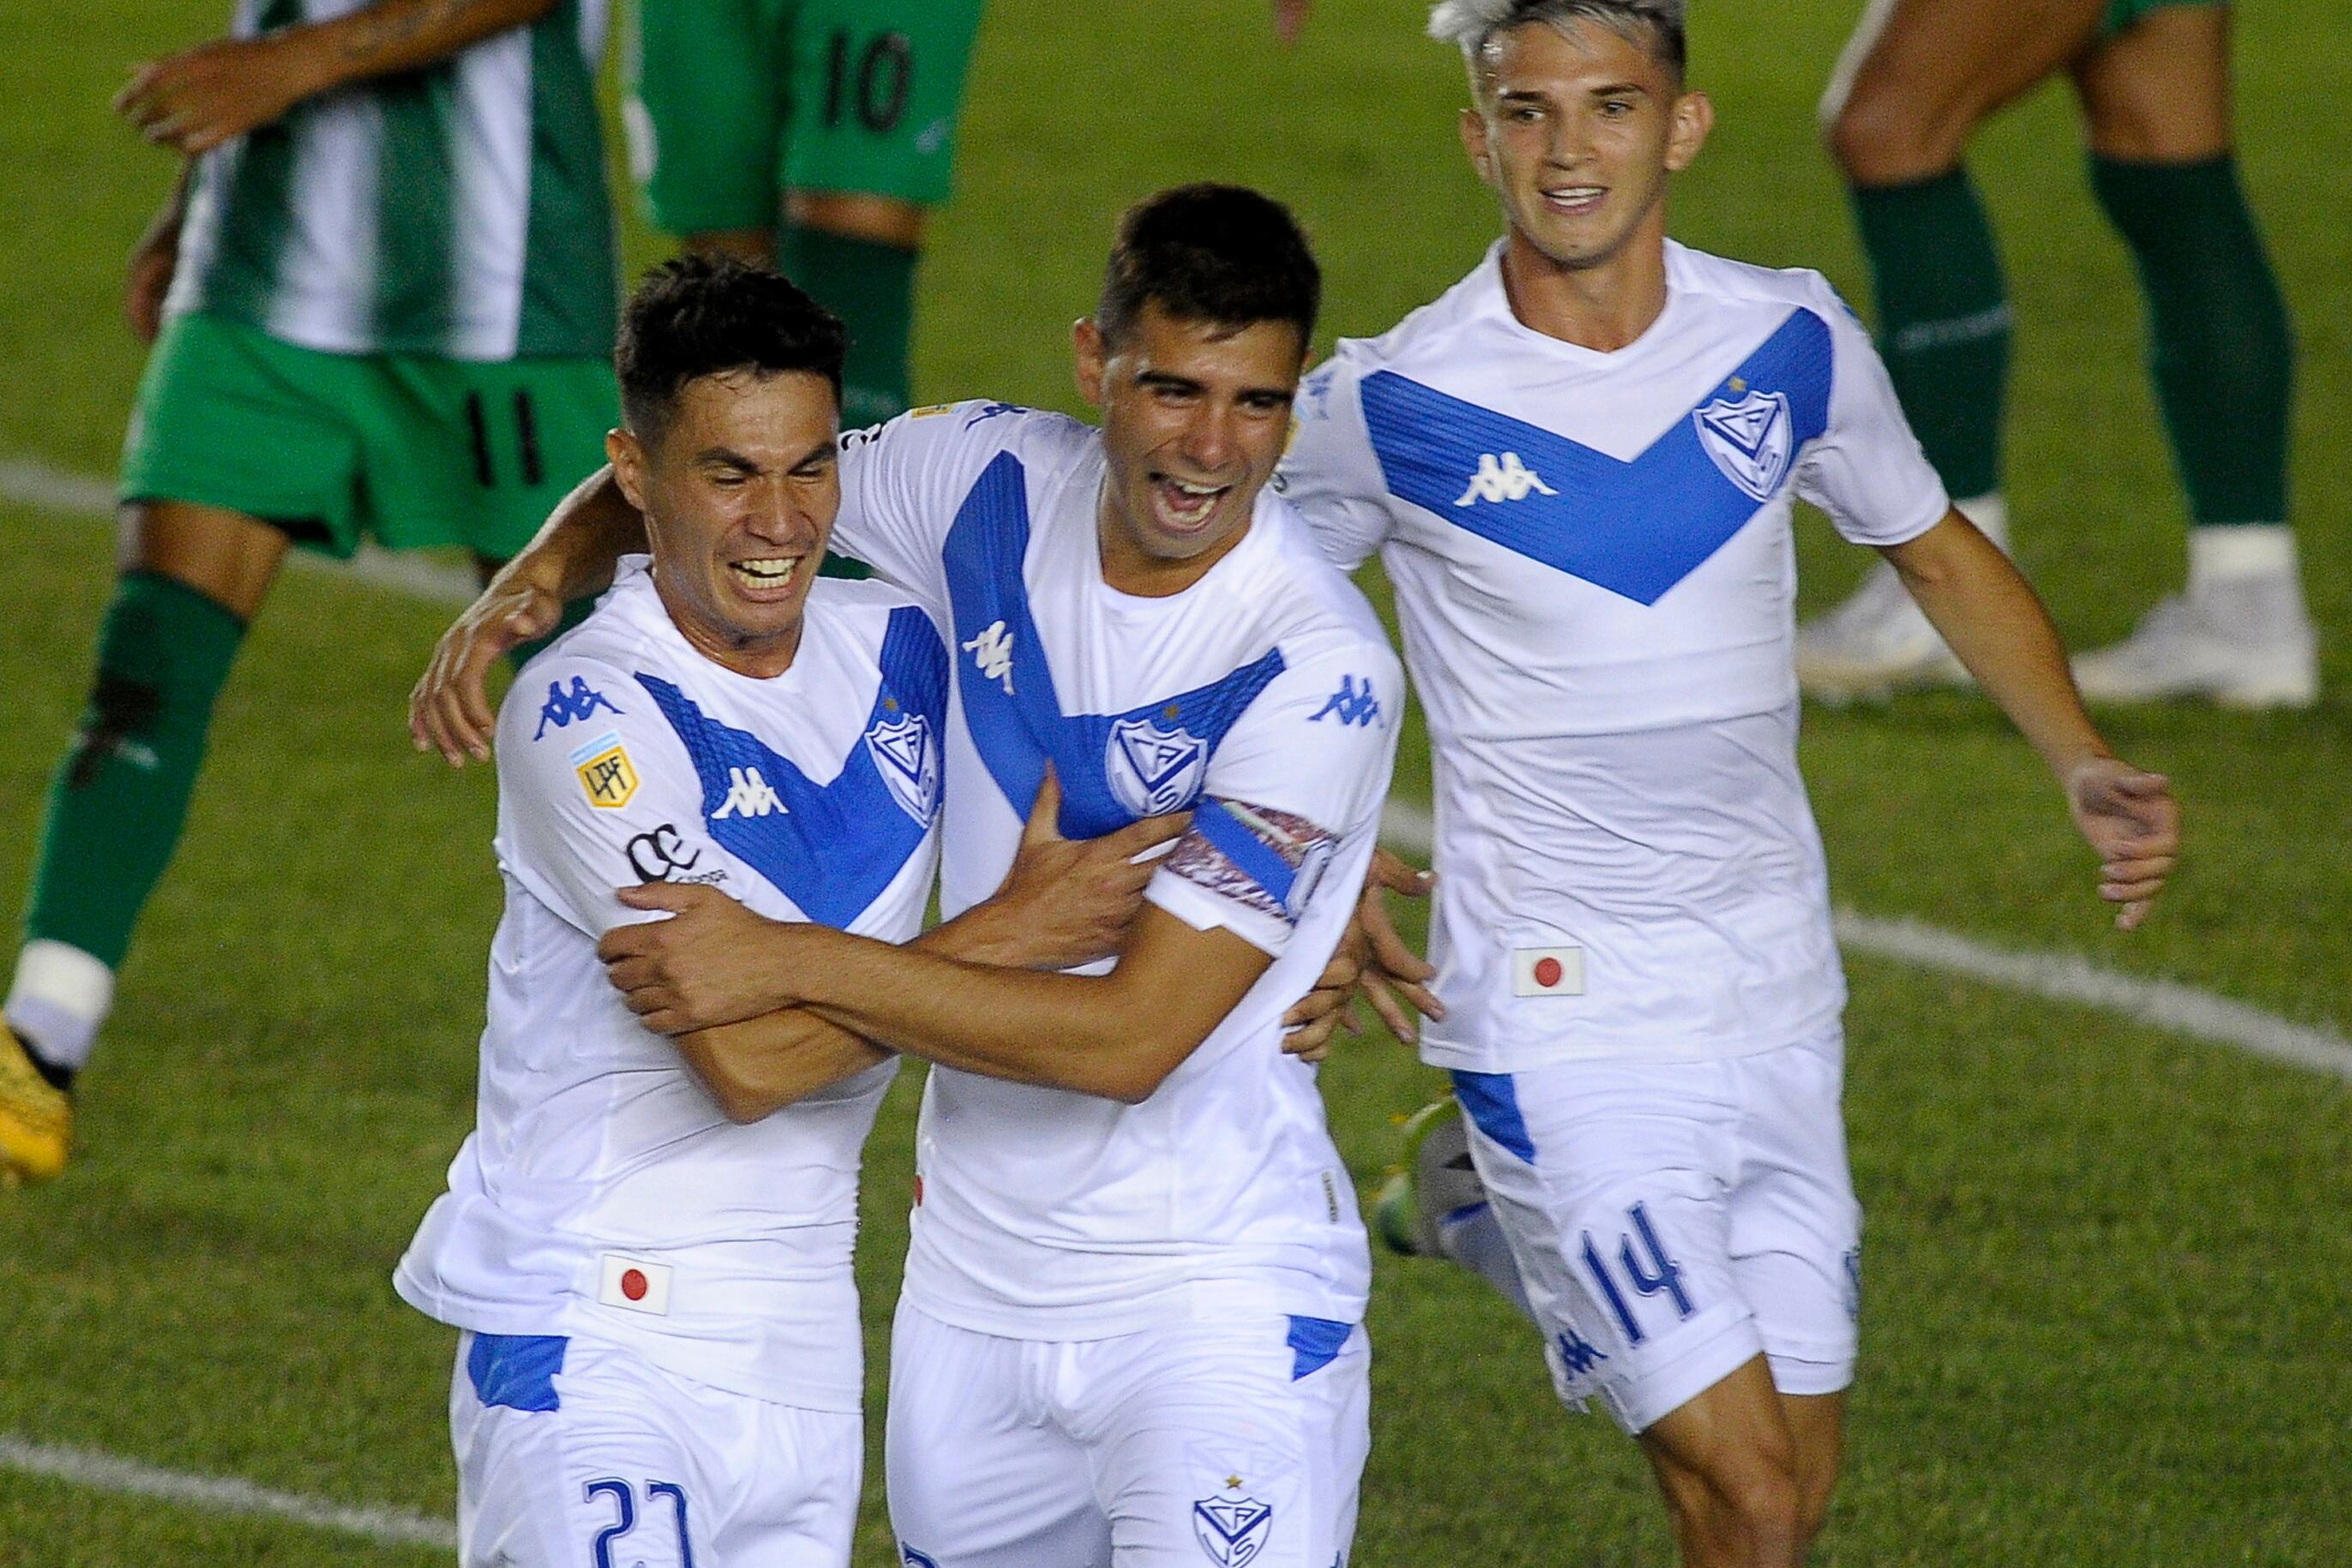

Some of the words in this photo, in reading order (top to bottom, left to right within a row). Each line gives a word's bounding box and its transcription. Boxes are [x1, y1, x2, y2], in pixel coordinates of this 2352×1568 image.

[824, 28, 911, 131] 10
[468, 390, 544, 487] 11
[1581, 1200, 1697, 1348] 14
[583, 1476, 695, 1568] 27
